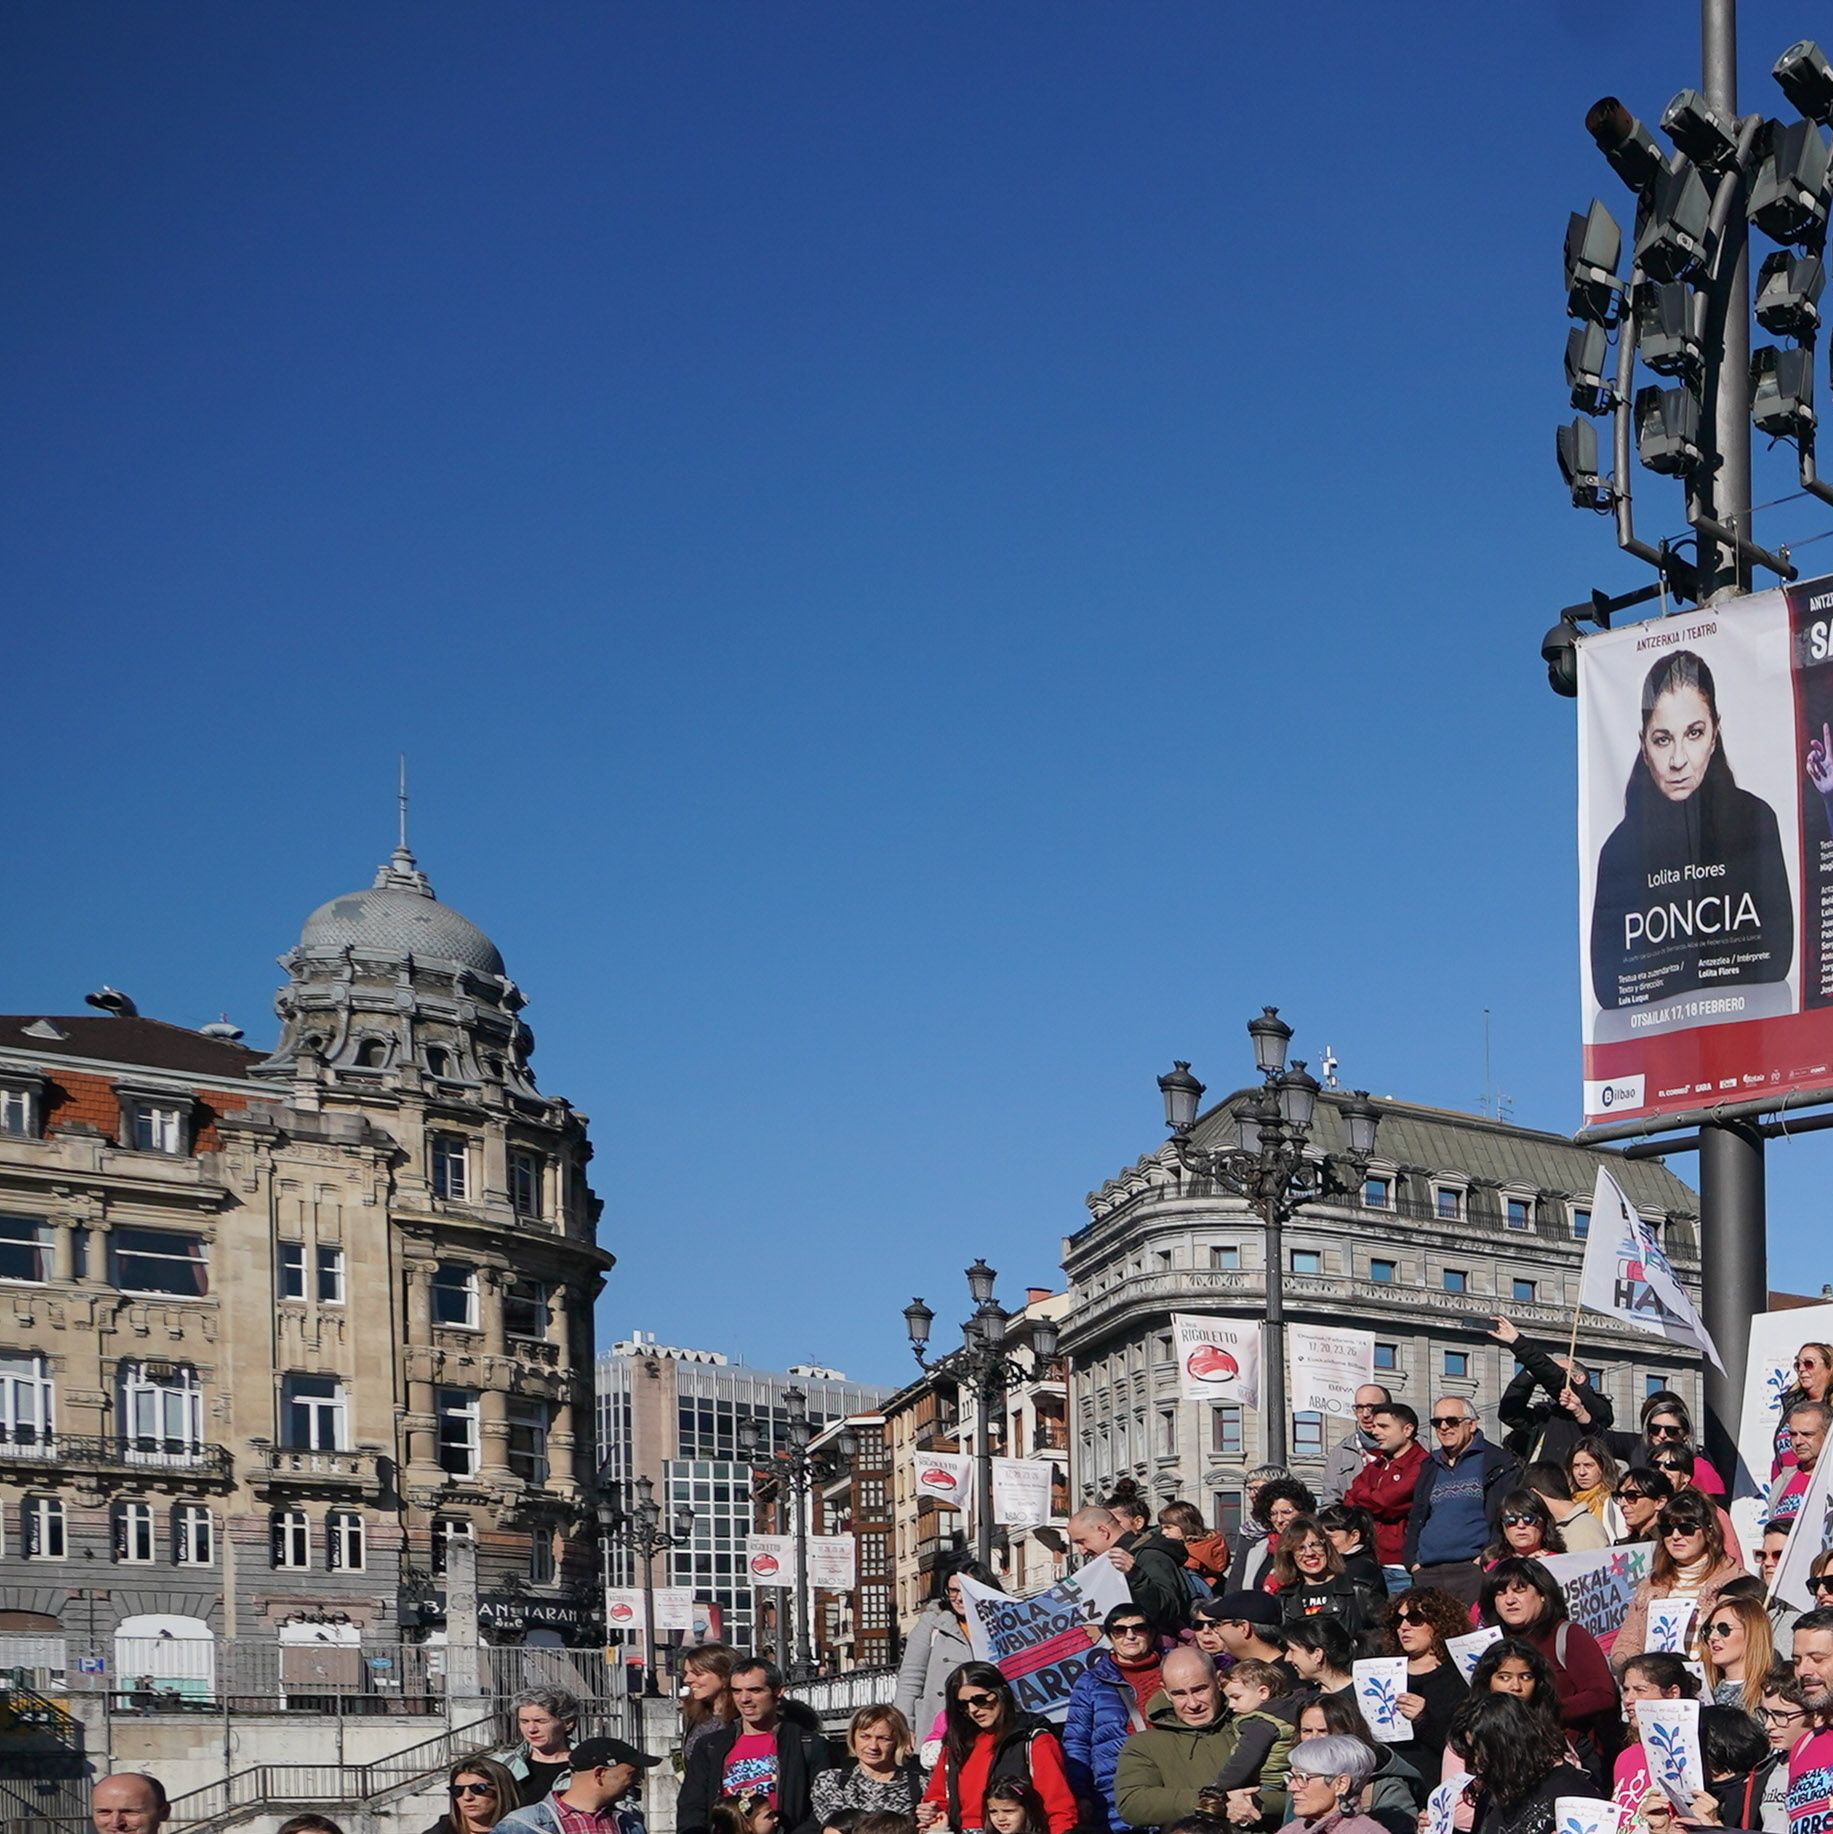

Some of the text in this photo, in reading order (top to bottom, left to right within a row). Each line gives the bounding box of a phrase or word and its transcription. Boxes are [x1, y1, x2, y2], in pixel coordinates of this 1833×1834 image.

[1636, 621, 1718, 652] ANTZERKIA TEATRO
[1647, 862, 1727, 889] Lolita Flores
[1624, 891, 1762, 951] PONCIA
[1697, 965, 1740, 980] Lolita Flores
[1630, 995, 1746, 1030] OTSAILAK 17, 18 FEBRERO
[1601, 1084, 1637, 1109] Bilbao
[1181, 1328, 1239, 1346] RIGOLETTO
[1308, 1395, 1342, 1413] ABAO
